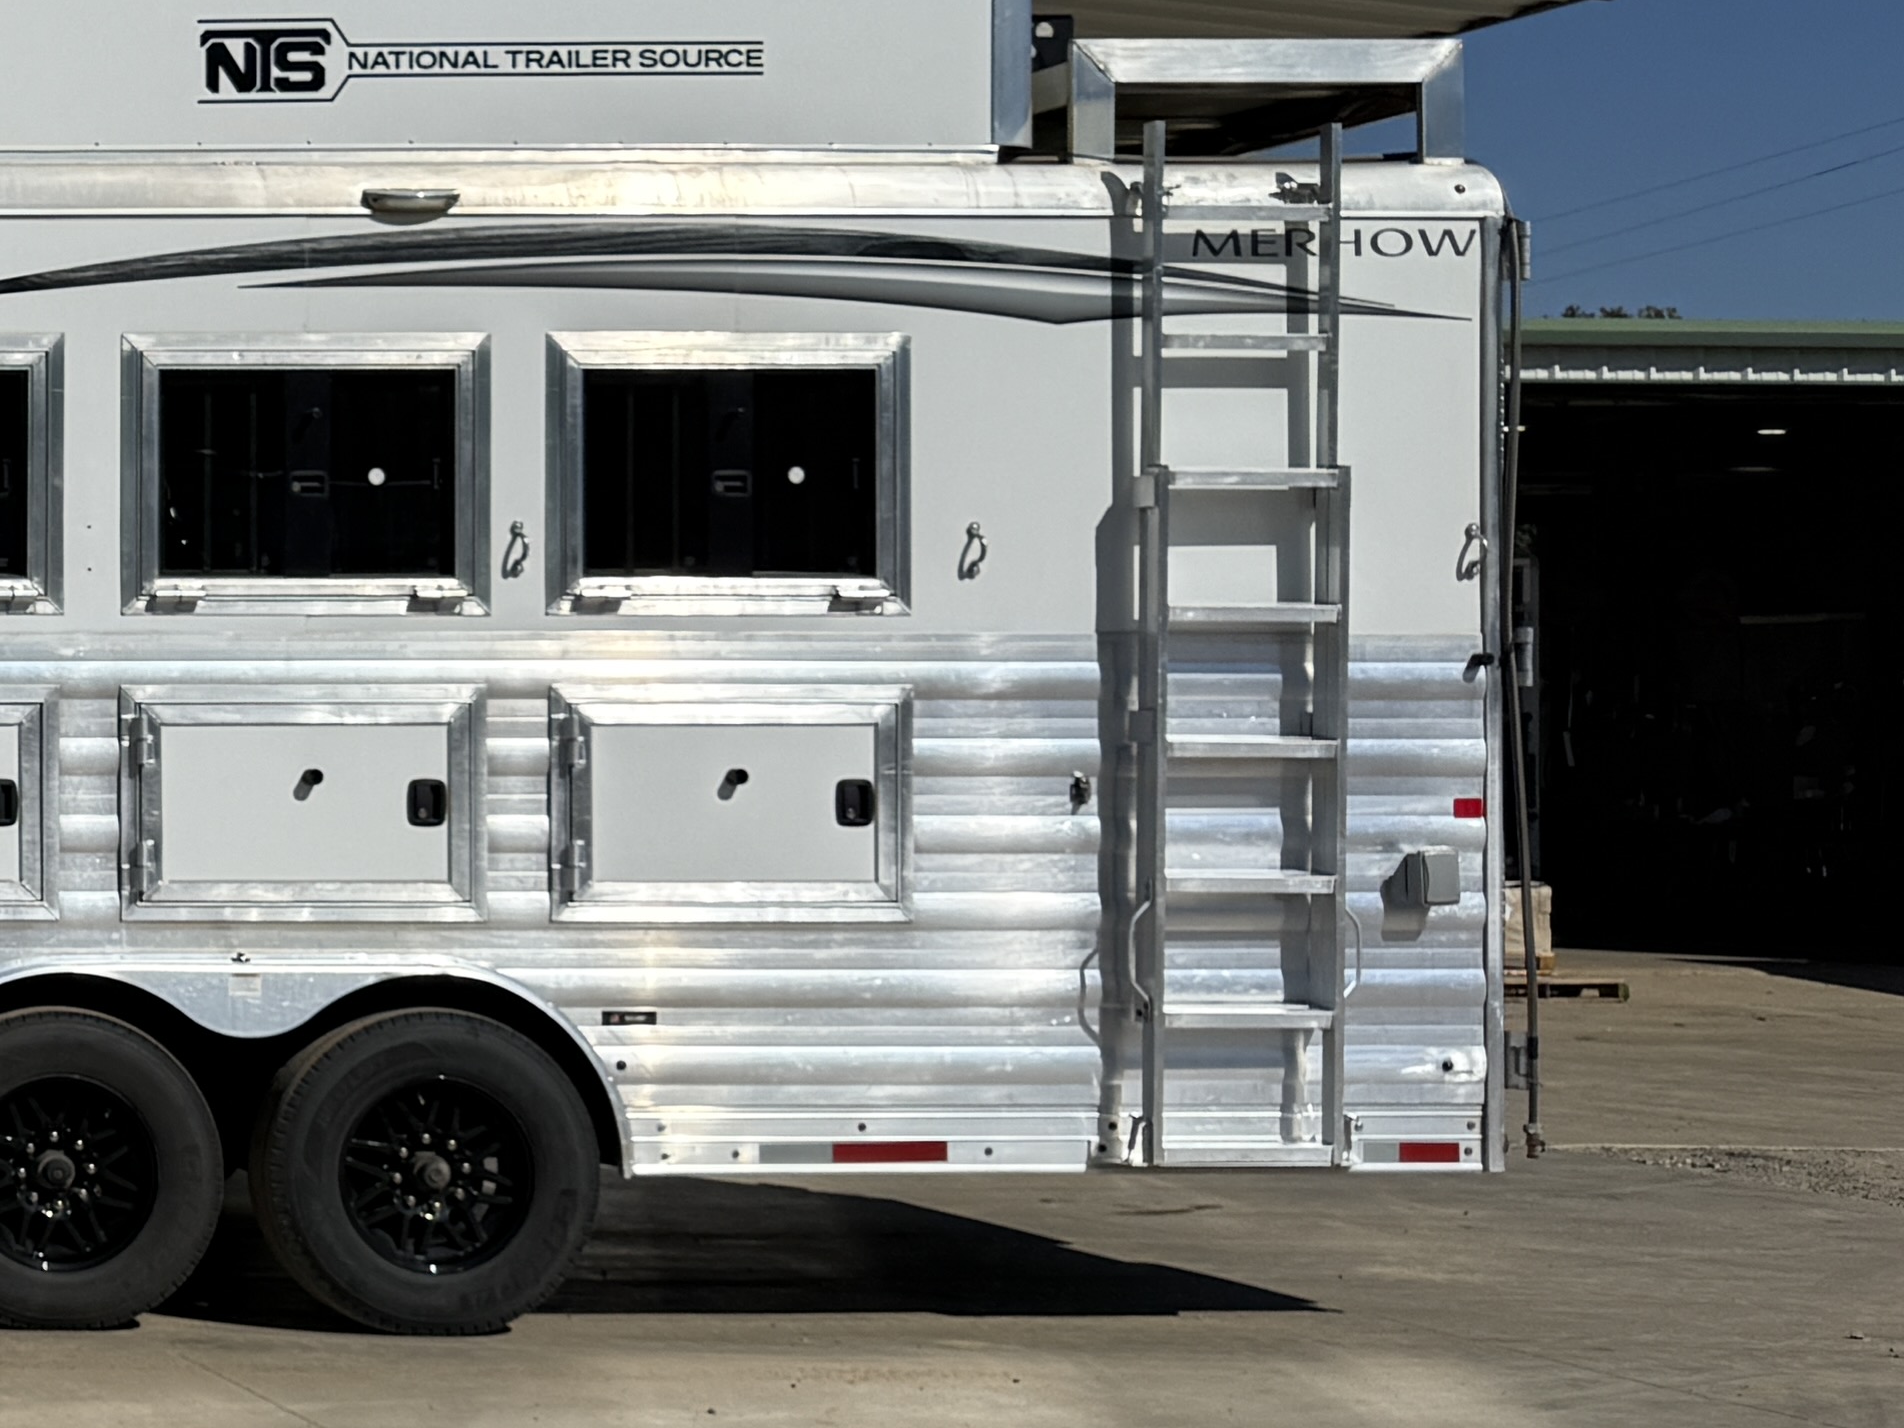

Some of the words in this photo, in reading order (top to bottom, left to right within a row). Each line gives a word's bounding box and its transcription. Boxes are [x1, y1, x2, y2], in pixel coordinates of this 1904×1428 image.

[200, 28, 331, 93] NTS
[348, 50, 499, 70] NATIONAL
[505, 49, 631, 69] TRAILER
[639, 48, 764, 68] SOURCE
